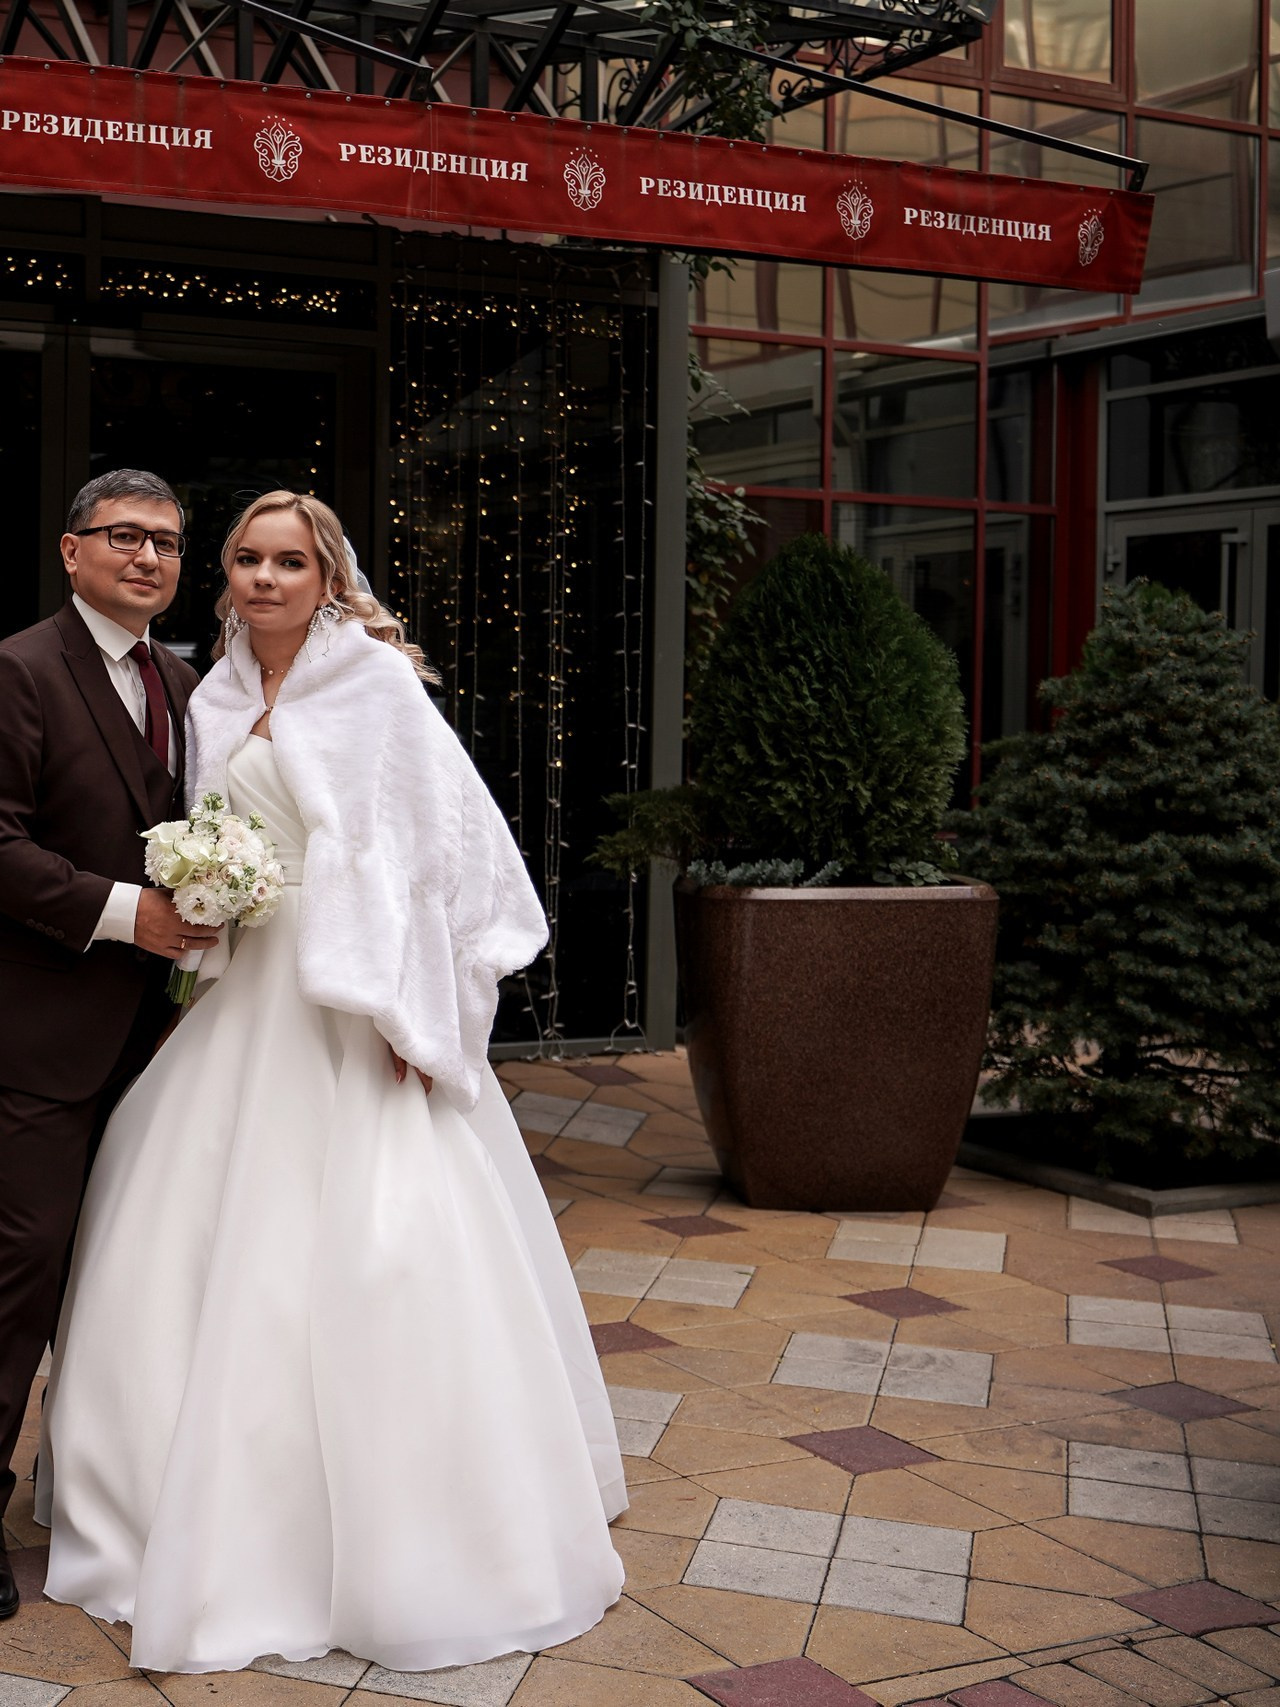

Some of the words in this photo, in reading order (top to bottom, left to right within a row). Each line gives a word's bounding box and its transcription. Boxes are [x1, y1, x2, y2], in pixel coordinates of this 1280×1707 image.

[1, 110, 213, 150] РЕЗИДЕНЦИЯ
[338, 142, 529, 182] РЕЗИДЕНЦИЯ
[639, 176, 807, 213] РЕЗИДЕНЦИЯ
[903, 207, 1052, 242] РЕЗИДЕНЦИЯ
